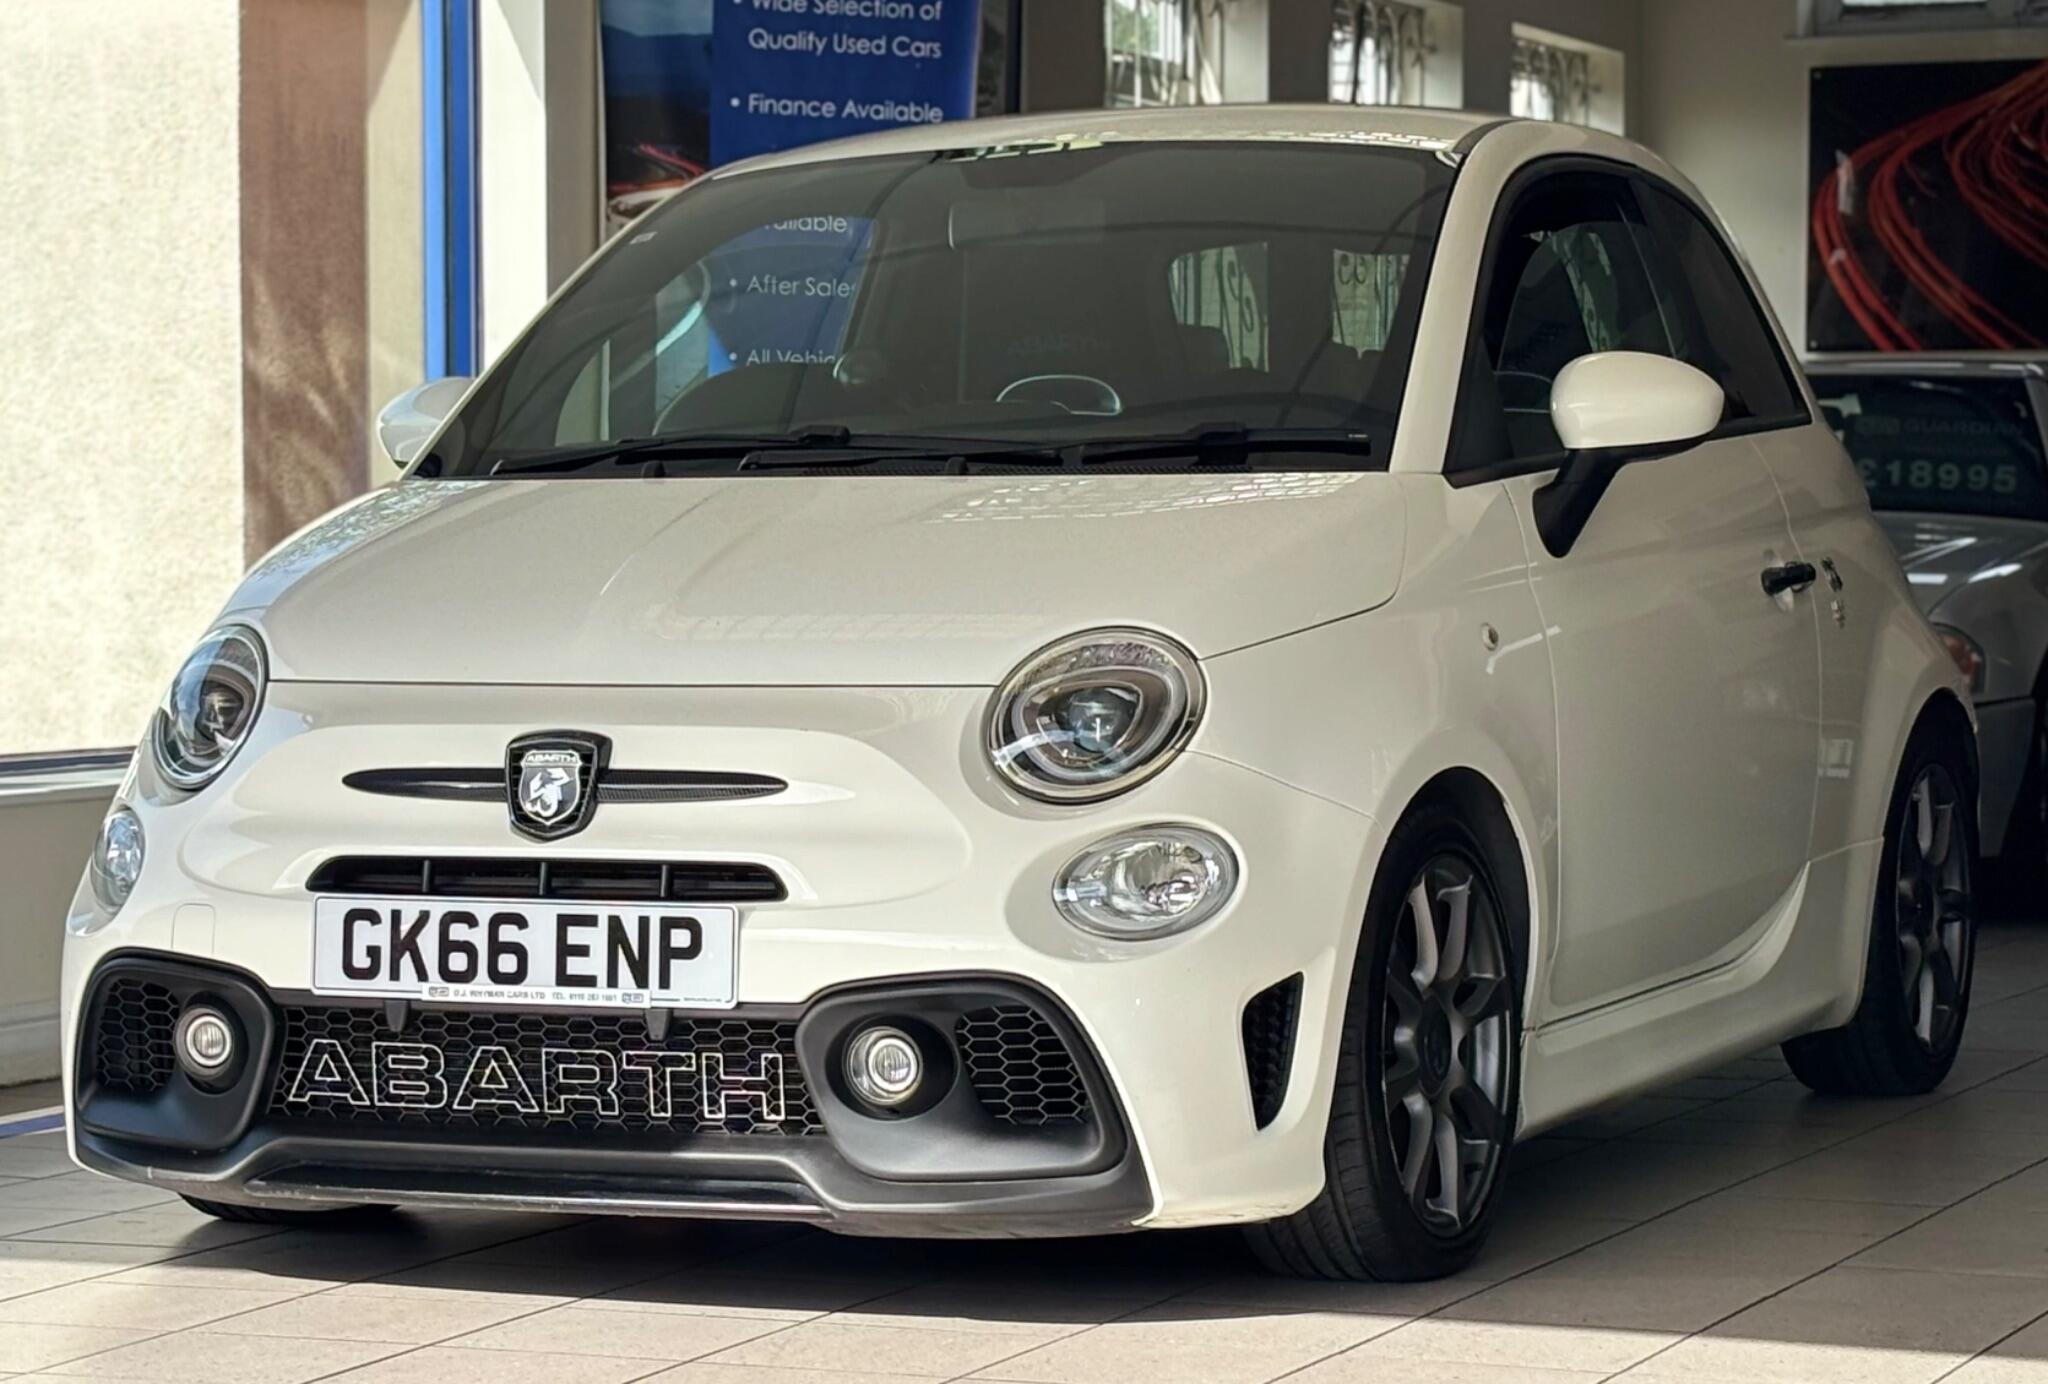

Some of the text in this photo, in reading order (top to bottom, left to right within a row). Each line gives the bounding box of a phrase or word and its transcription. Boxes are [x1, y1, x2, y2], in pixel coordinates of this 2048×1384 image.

[812, 0, 915, 19] Selection
[918, 0, 943, 20] of
[748, 27, 943, 59] Quality Used Cars
[748, 93, 944, 123] Finance Available
[746, 274, 800, 295] After
[746, 349, 770, 366] All
[1857, 458, 2017, 493] £18995
[526, 753, 577, 763] ABARTH
[342, 907, 704, 990] GK66 ENP
[287, 1038, 787, 1122] ABARTH
